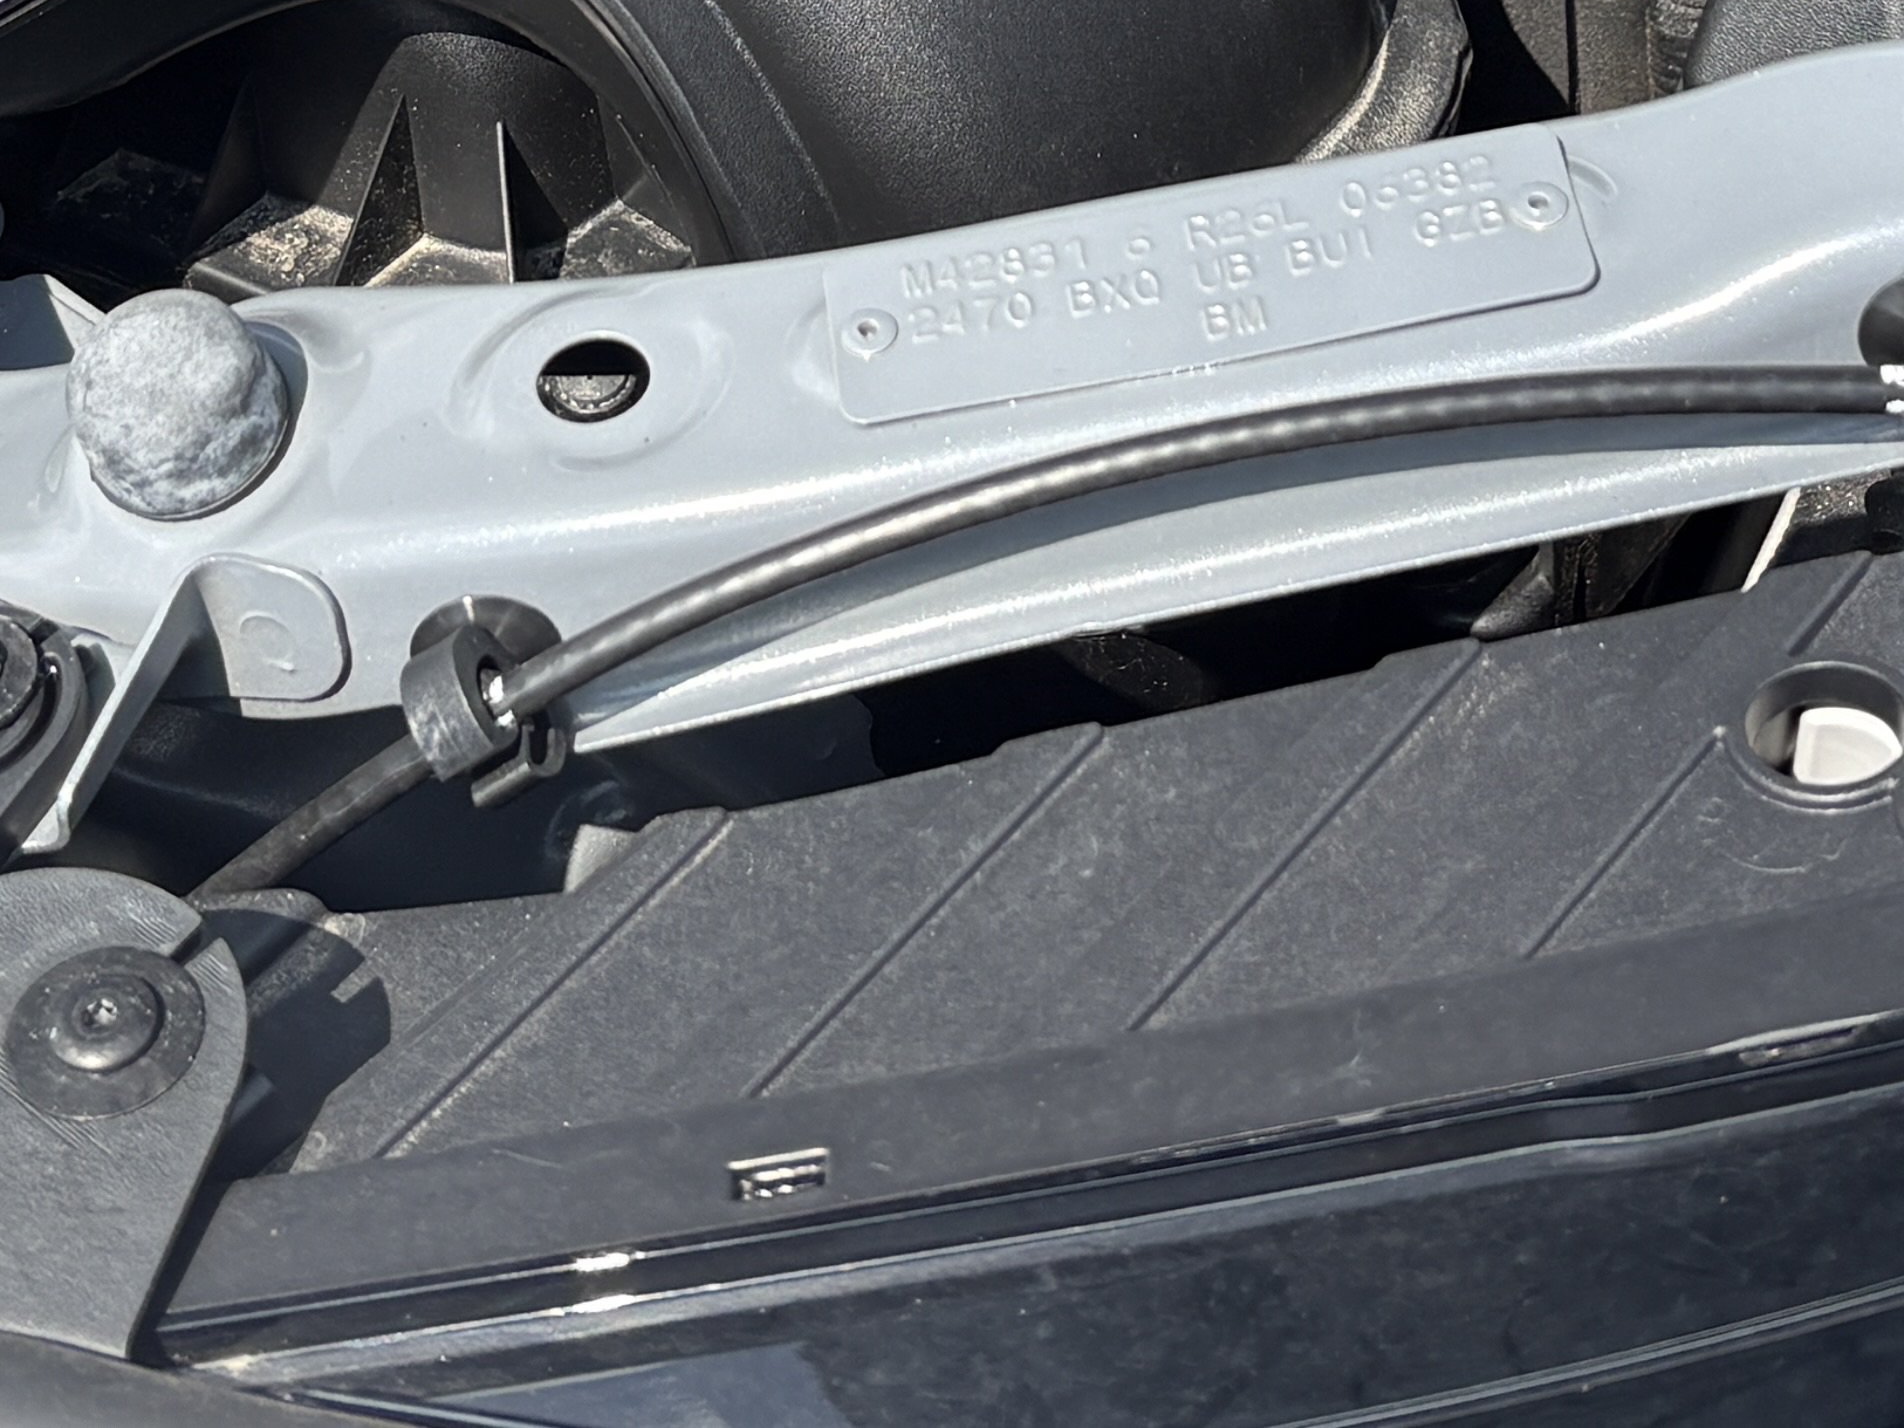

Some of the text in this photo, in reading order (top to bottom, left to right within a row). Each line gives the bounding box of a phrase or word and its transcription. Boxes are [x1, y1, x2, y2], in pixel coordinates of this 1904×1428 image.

[907, 292, 1033, 344] 2470
[1192, 251, 1253, 292] UB
[1202, 295, 1268, 341] BM
